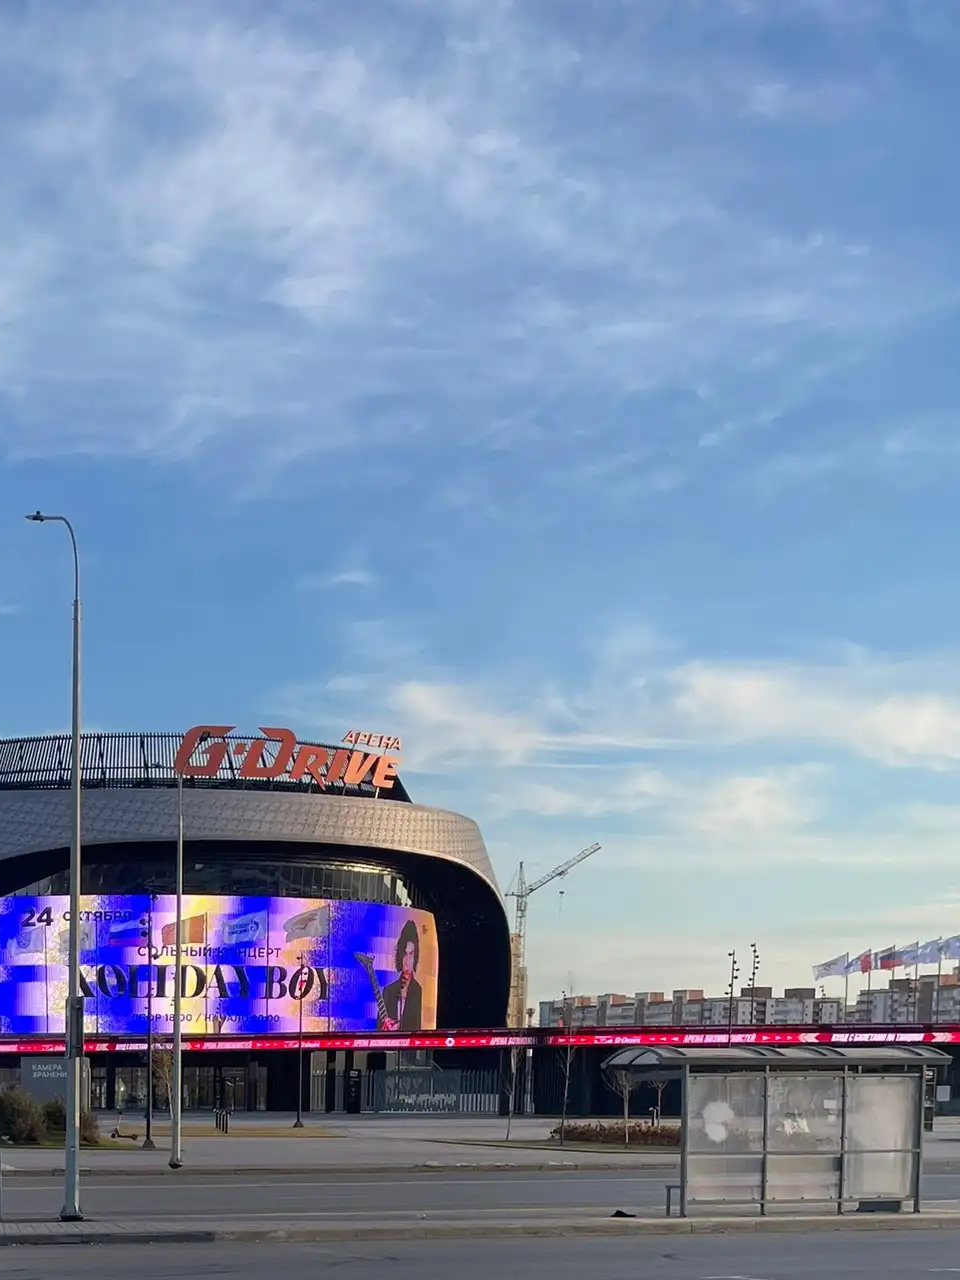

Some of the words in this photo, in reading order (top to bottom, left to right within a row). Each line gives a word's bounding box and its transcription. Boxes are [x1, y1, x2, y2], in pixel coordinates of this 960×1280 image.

[341, 730, 402, 751] АРЕНА
[21, 906, 54, 927] 24
[214, 947, 282, 959] КНЦЕРТ
[32, 1071, 68, 1079] ХРАНЕНИ
